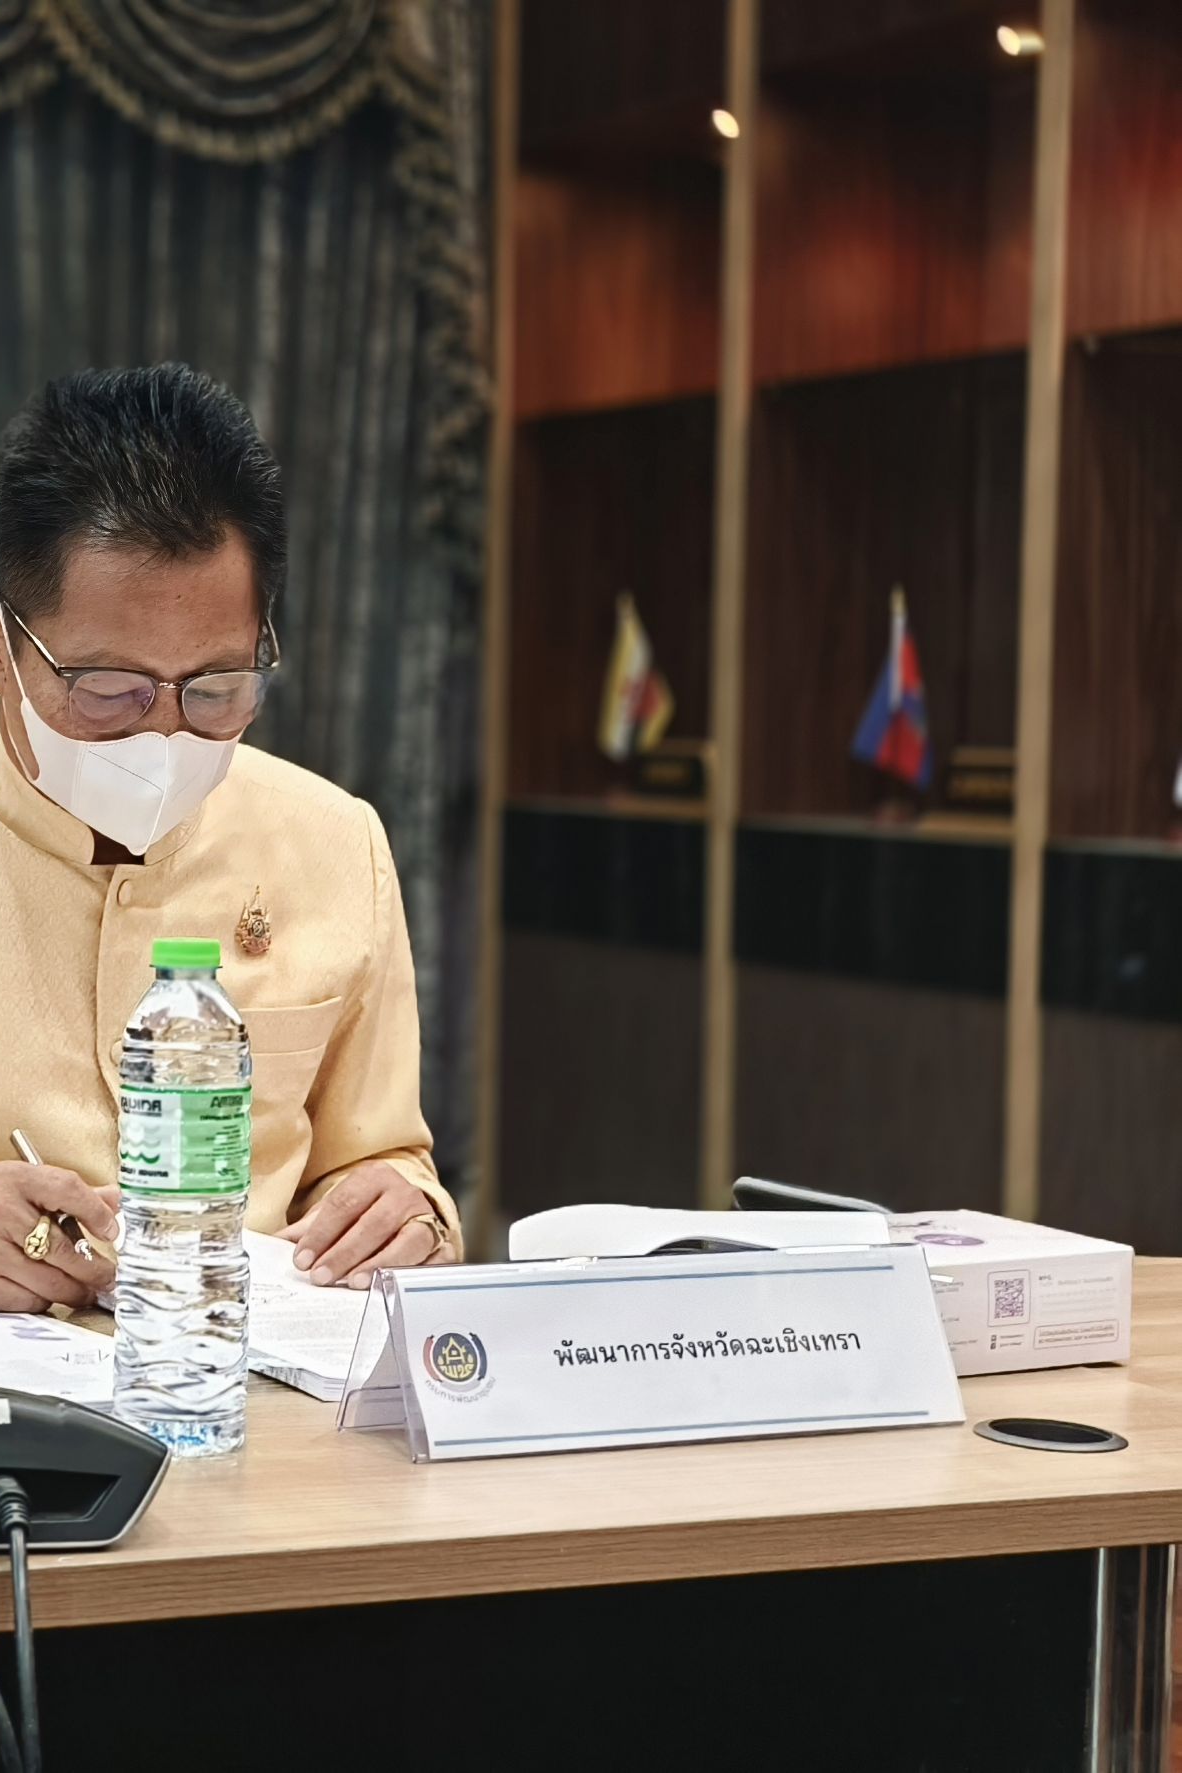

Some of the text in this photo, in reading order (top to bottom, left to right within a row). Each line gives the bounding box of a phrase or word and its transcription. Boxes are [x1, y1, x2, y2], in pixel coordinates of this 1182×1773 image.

[553, 1327, 861, 1367] พัฒนาการจังหวัดฉะเชิงเทรา
